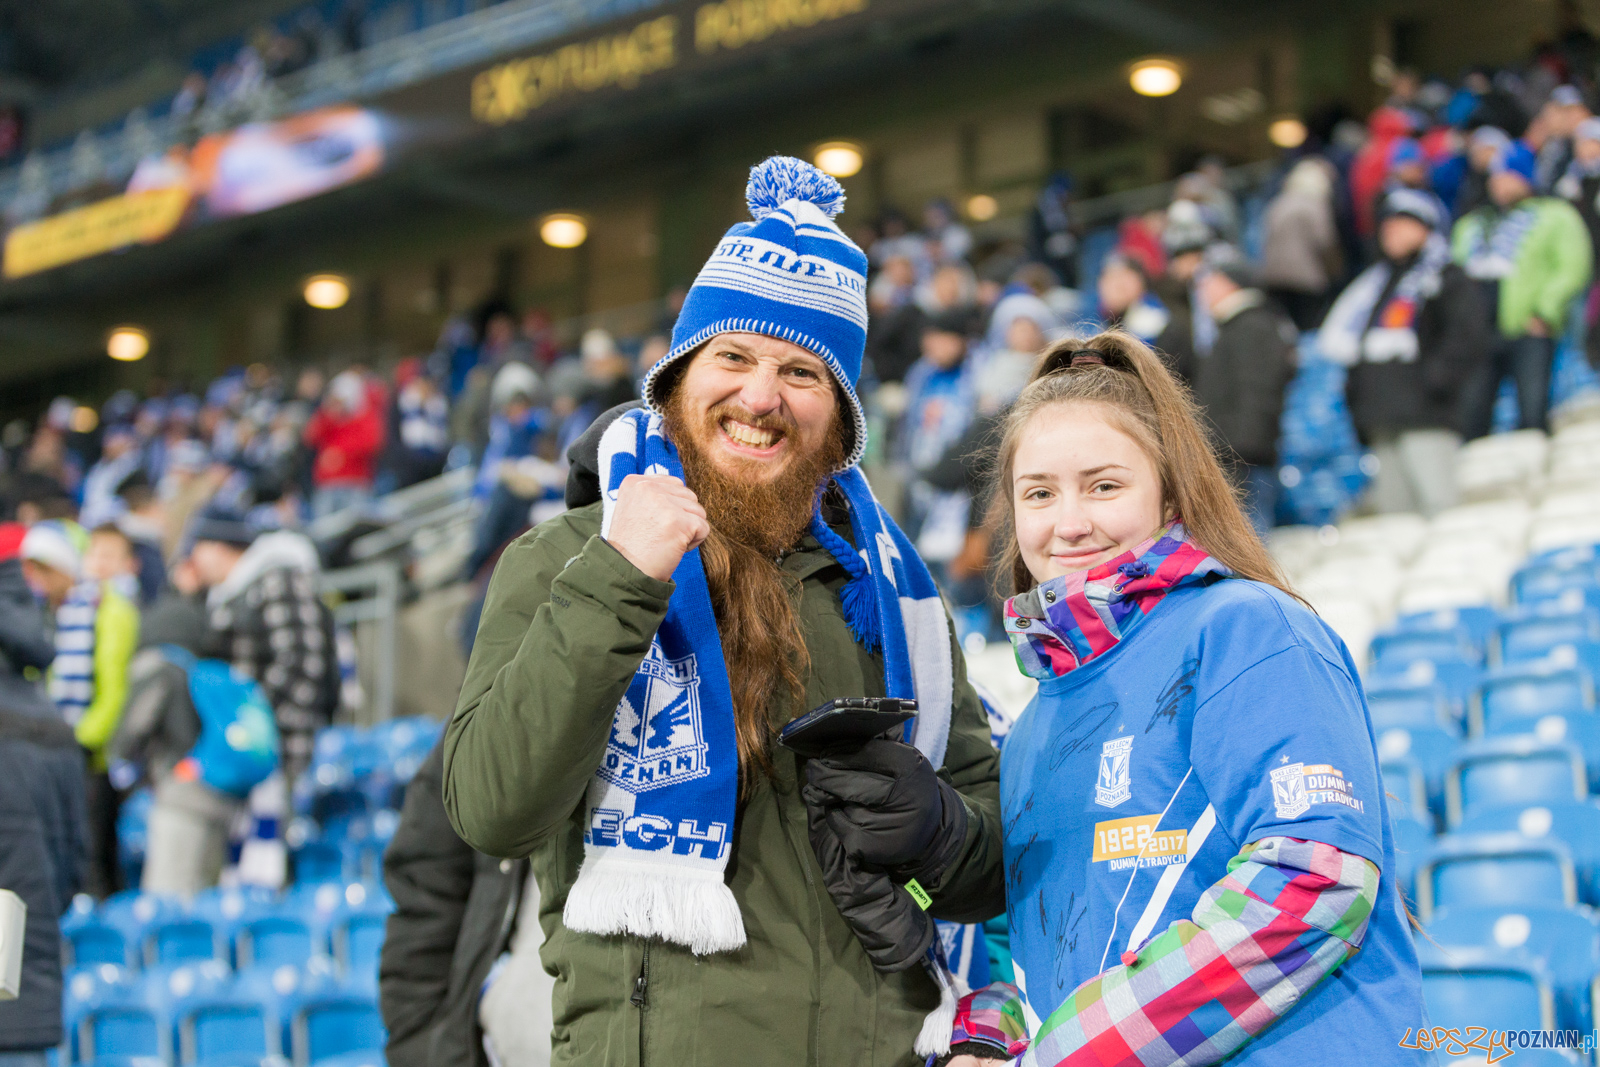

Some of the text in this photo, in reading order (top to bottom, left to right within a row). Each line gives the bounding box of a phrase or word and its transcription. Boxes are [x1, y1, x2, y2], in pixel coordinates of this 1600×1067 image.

[1308, 775, 1347, 792] DUMNI
[1309, 793, 1318, 804] Z
[583, 807, 728, 861] ECH
[1098, 824, 1185, 854] 1922 2017
[1139, 859, 1145, 868] Z
[1146, 854, 1185, 868] TRADYCJI
